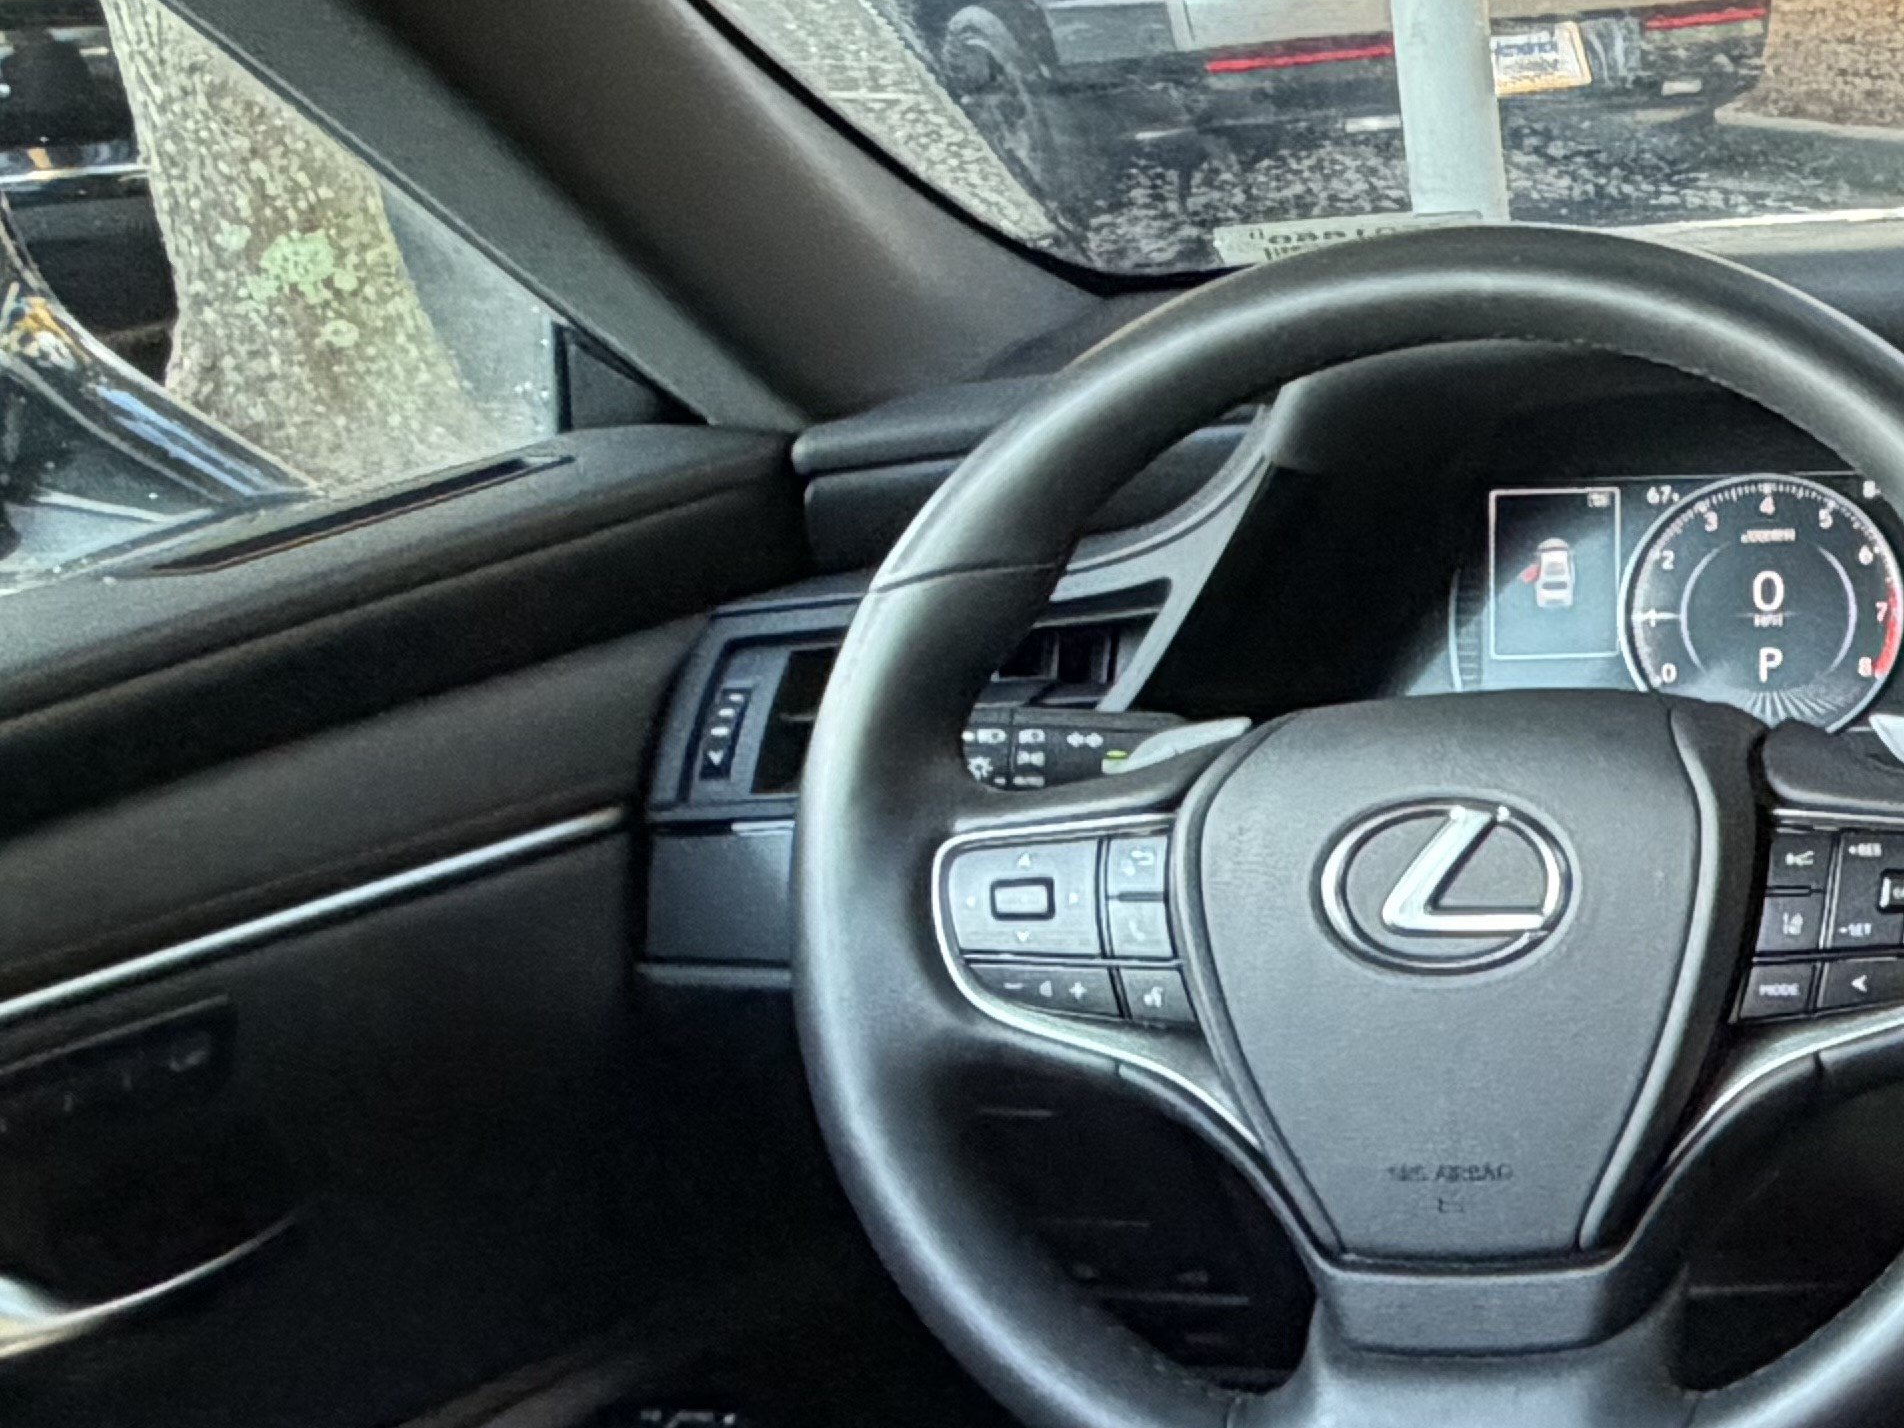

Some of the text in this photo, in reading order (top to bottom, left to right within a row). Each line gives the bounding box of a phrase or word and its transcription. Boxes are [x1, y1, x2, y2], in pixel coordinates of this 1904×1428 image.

[1758, 496, 1776, 516] 4
[1703, 511, 1719, 532] 3
[1818, 509, 1834, 529] 5
[1661, 549, 1676, 571] 2
[1857, 543, 1875, 566] 6
[1752, 570, 1785, 612] 0
[1875, 601, 1888, 623] 7
[1661, 663, 1678, 684] 0
[1758, 646, 1784, 684] P
[1857, 657, 1873, 677] 8
[1758, 982, 1801, 997] MODE
